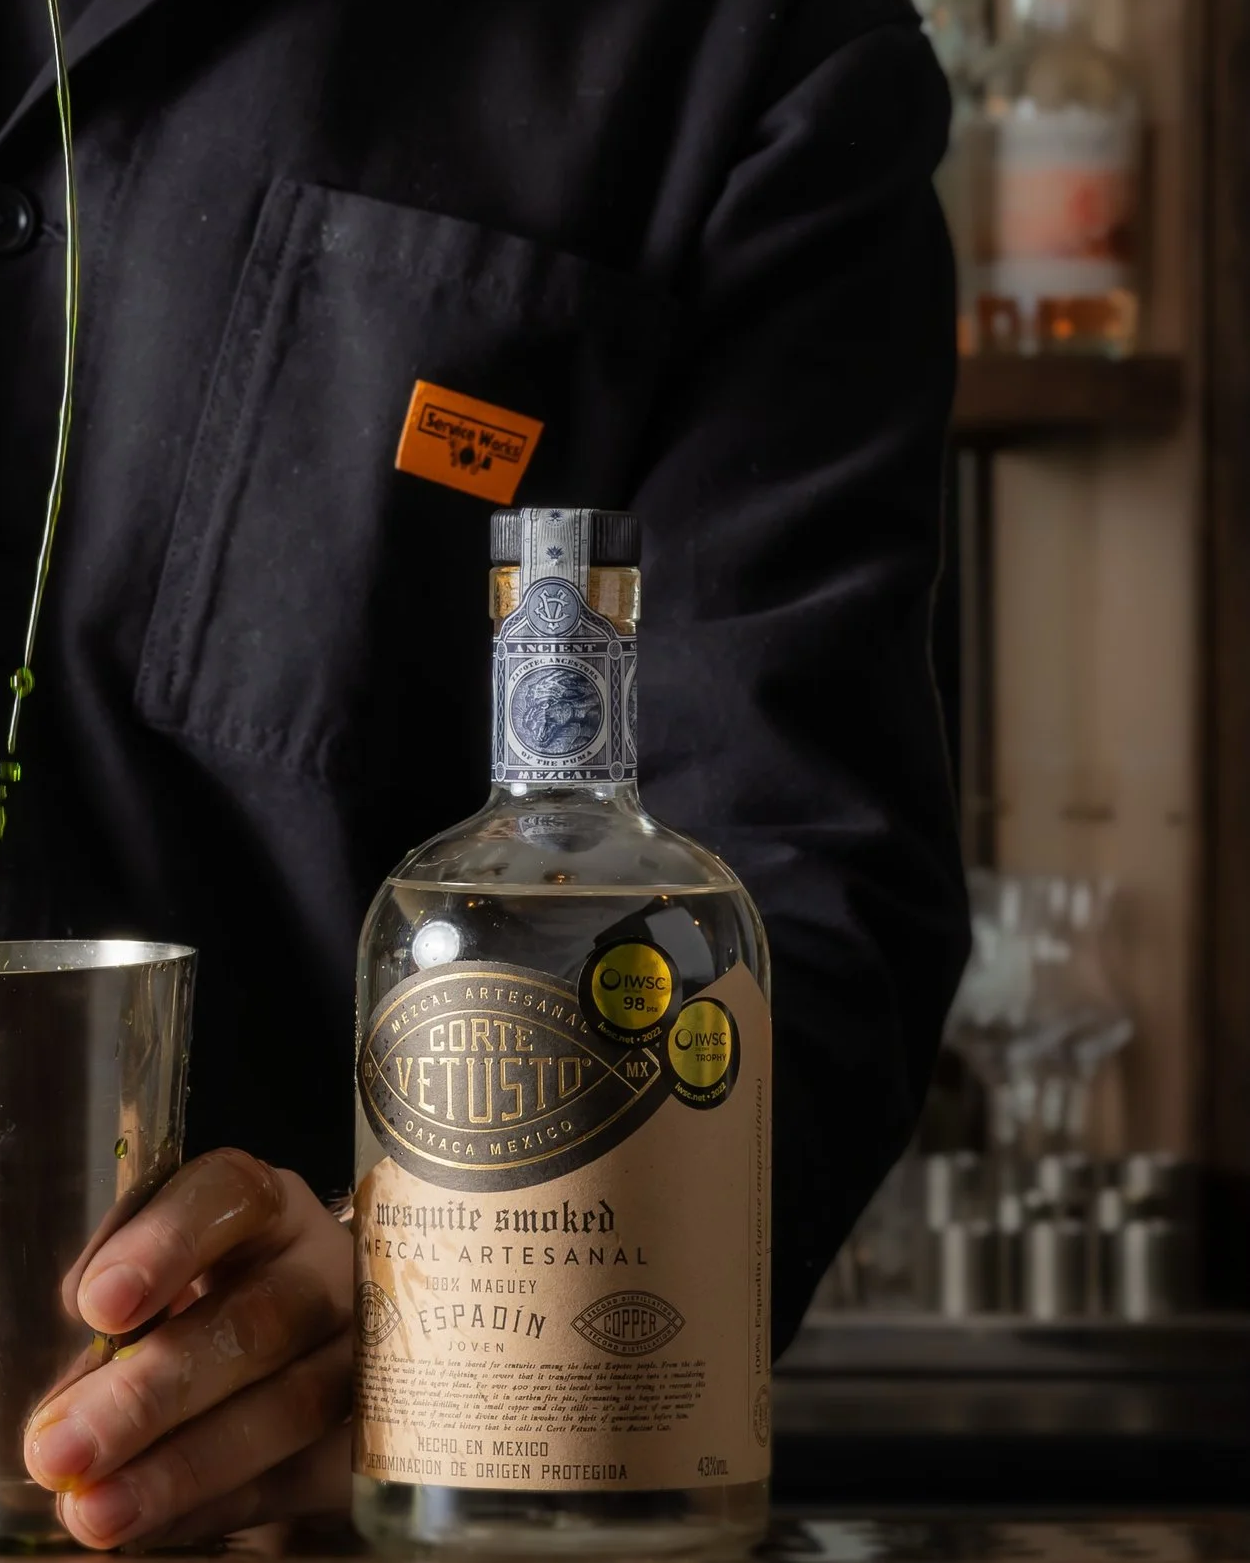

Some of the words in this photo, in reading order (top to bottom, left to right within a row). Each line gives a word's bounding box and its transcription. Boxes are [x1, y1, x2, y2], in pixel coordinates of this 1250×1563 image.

[426, 411, 475, 442] Service
[479, 429, 521, 456] Works
[516, 644, 596, 653] ANCIENT
[549, 657, 598, 680] ANCESTORS
[521, 751, 533, 759] OF
[536, 758, 558, 766] THE
[563, 750, 592, 765] PUMA
[518, 771, 597, 779] MEZCAL
[624, 974, 666, 990] IWSC
[391, 991, 452, 1034] MEZCAL
[465, 987, 588, 1034] ARTESANAL
[623, 996, 645, 1011] 98
[429, 1018, 533, 1052] CORTE
[641, 1026, 662, 1042] 2022
[695, 1032, 726, 1046] IWSC
[695, 1053, 727, 1062] TROPHY
[626, 1062, 649, 1078] MX
[675, 1081, 706, 1101] iwsc.net
[711, 1081, 727, 1099] 2022
[405, 1120, 474, 1156] OAXACA
[490, 1119, 572, 1156] MEXICO
[376, 1201, 482, 1237] mesquite
[494, 1198, 615, 1235] smoked
[458, 1246, 648, 1266] ARTESANAL
[471, 1278, 537, 1294] MAGUEY
[587, 1298, 618, 1318] SECOND
[418, 1304, 547, 1339] ESPADÍN
[604, 1309, 657, 1338] COPPER
[448, 1341, 505, 1354] JOVEN
[588, 1331, 619, 1351] SECOND
[489, 1362, 499, 1370] for
[540, 1363, 563, 1371] among
[449, 1370, 478, 1380] lightning
[548, 1373, 592, 1381] transformed
[543, 1394, 558, 1403] fire
[561, 1395, 578, 1403] pits,
[551, 1404, 566, 1412] clay
[578, 1415, 597, 1423] spirit
[546, 1424, 566, 1432] Corte
[417, 1436, 457, 1454] HECHO
[466, 1439, 483, 1455] EN
[493, 1441, 549, 1457] MEXICO
[451, 1461, 467, 1477] DE
[476, 1463, 531, 1479] ORIGEN
[542, 1464, 628, 1480] PROTEGIDA
